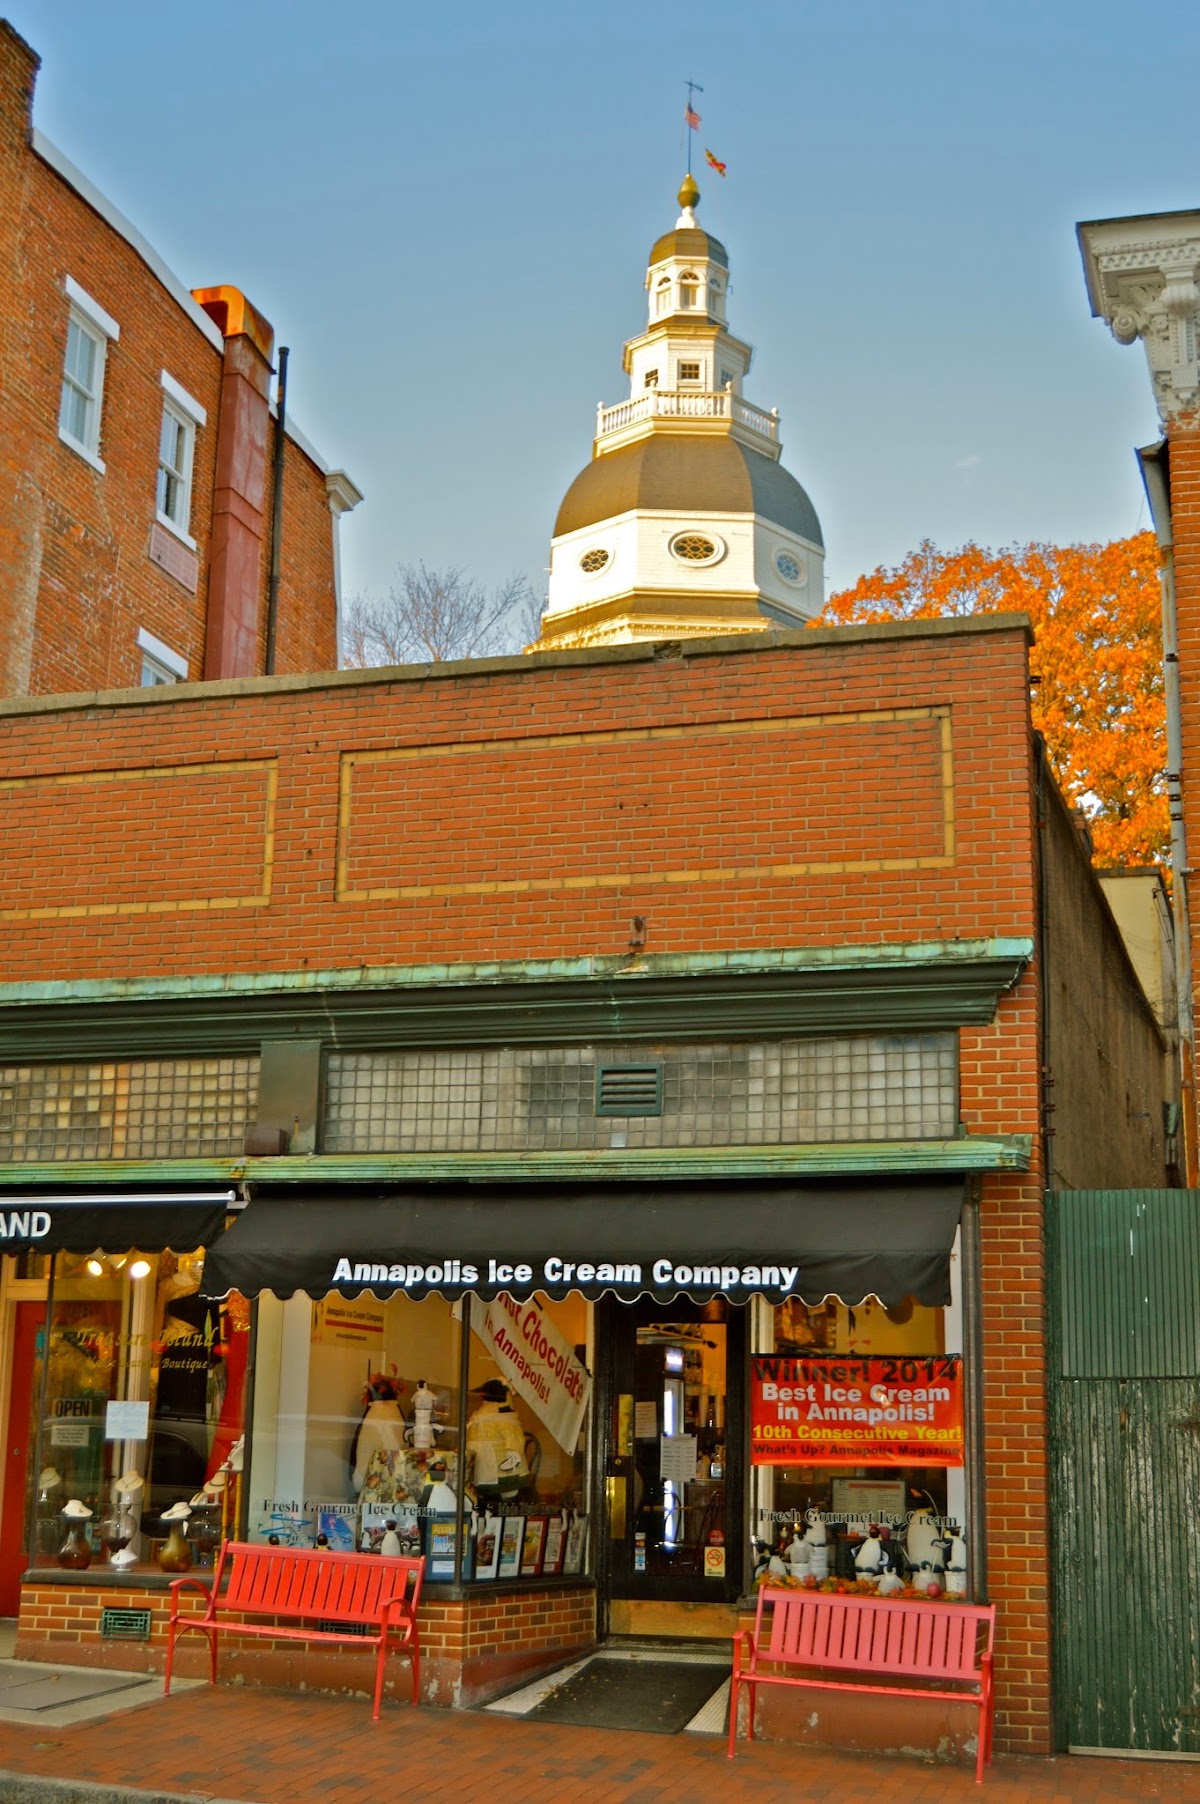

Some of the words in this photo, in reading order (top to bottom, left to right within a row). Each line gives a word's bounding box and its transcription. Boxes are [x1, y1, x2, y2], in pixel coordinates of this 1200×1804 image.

[332, 1258, 479, 1286] Annapolis
[488, 1260, 532, 1283] Ice
[544, 1258, 641, 1283] Cream
[653, 1259, 799, 1291] Company
[158, 1326, 219, 1348] Island
[162, 1357, 208, 1373] Boutique
[494, 1327, 550, 1404] Annapolis!
[522, 1310, 584, 1405] Chocolate
[754, 1359, 869, 1382] Winner!
[882, 1359, 957, 1383] 2014
[762, 1383, 816, 1402] Best
[824, 1383, 862, 1402] Ice
[870, 1384, 950, 1403] Cream
[55, 1400, 90, 1417] OPEN
[778, 1402, 799, 1420] in
[807, 1402, 935, 1425] Annapolis!
[753, 1425, 792, 1438] 10th
[797, 1425, 908, 1439] Consecutive
[914, 1426, 961, 1440] Year!
[754, 1444, 796, 1454] What's
[801, 1445, 825, 1456] Up?
[829, 1445, 894, 1456] Annapolis
[898, 1446, 960, 1458] Magazine
[263, 1499, 299, 1512] Fresh
[304, 1500, 362, 1514] Gourmet
[368, 1502, 388, 1515] Ice
[391, 1503, 437, 1518] Cream
[759, 1508, 801, 1522] Fresh
[804, 1508, 874, 1524] Gourmet
[878, 1510, 901, 1524] Ice
[905, 1511, 958, 1527] Cream
